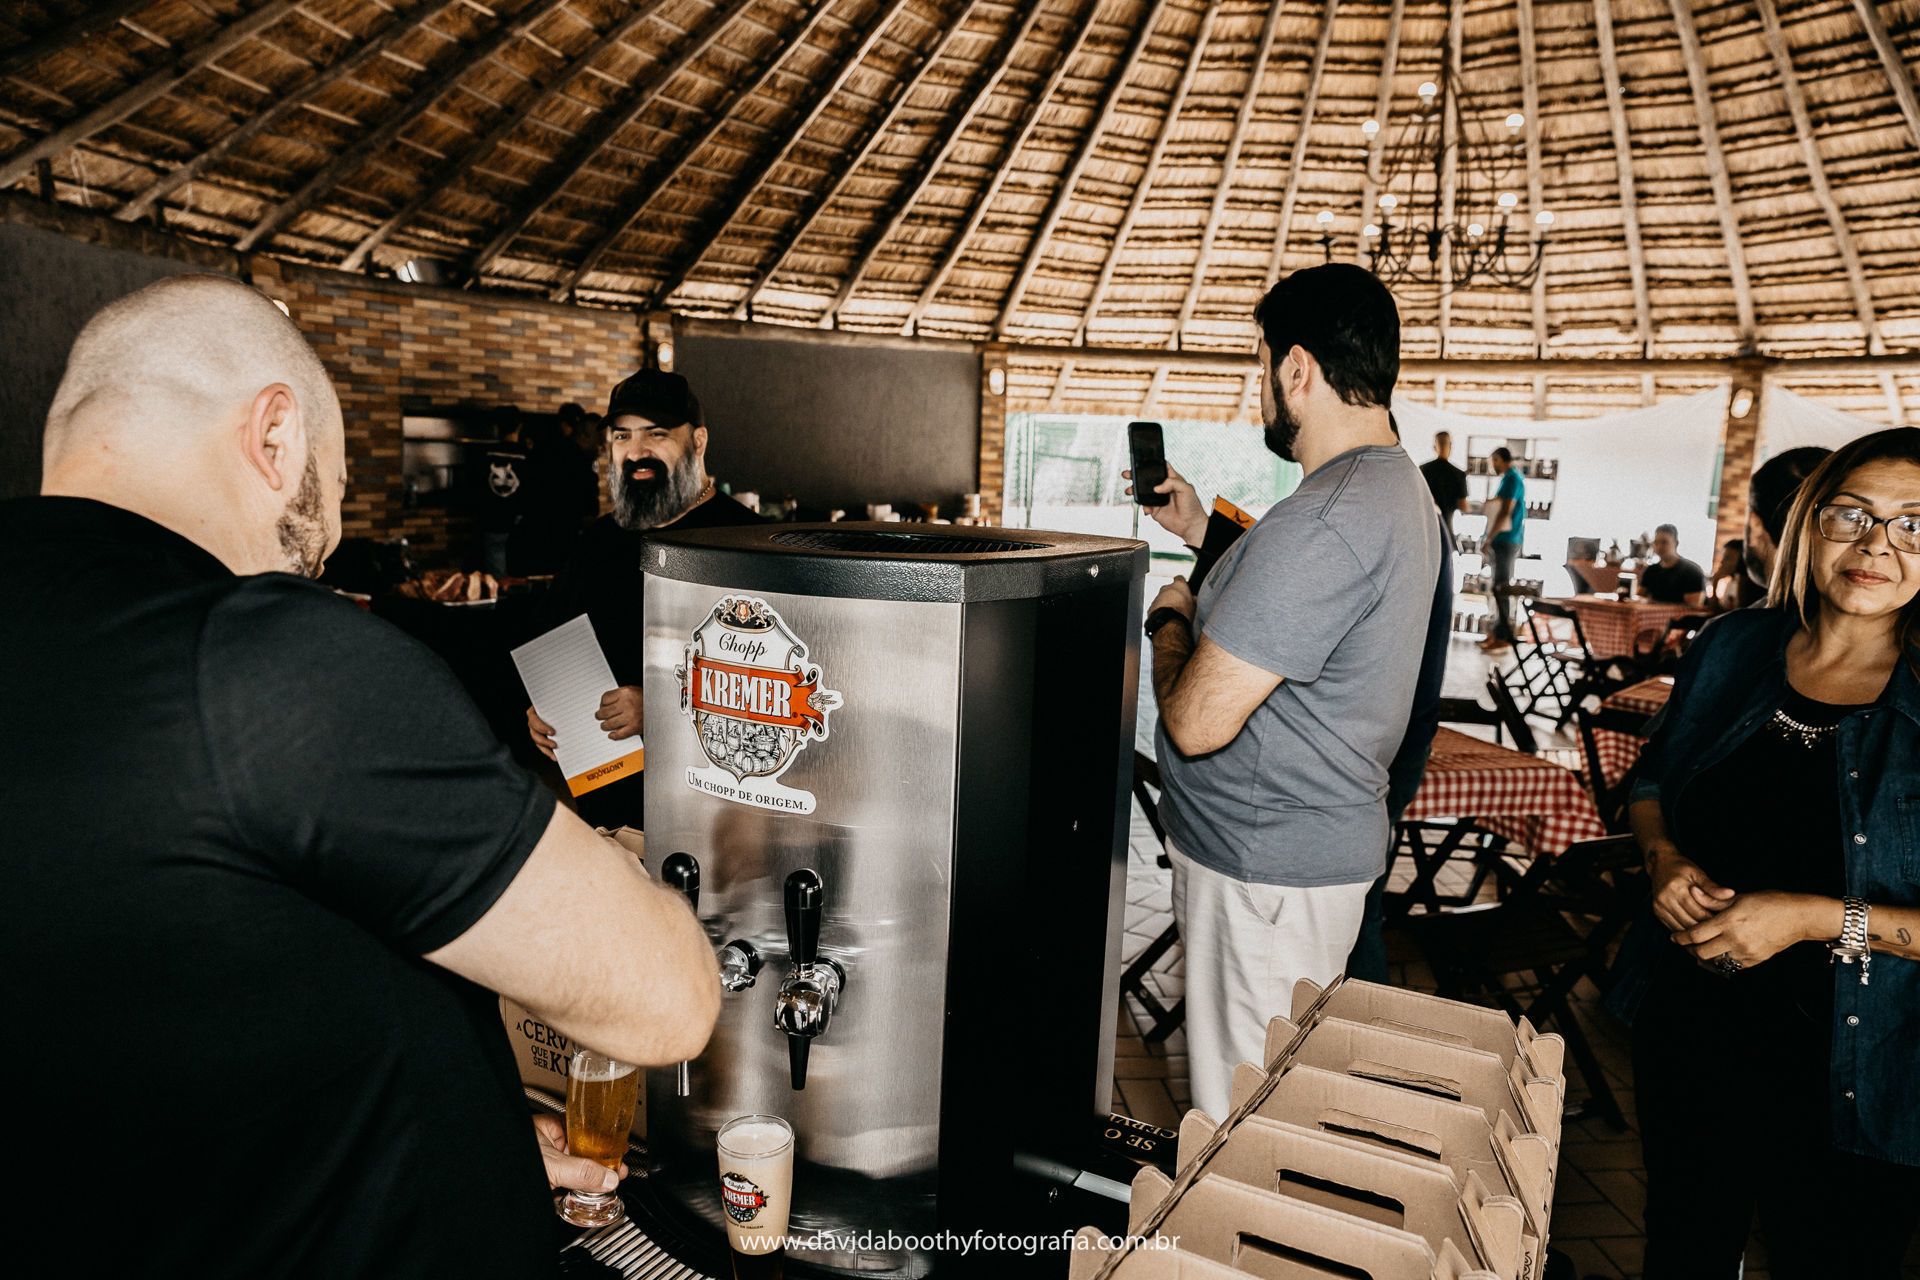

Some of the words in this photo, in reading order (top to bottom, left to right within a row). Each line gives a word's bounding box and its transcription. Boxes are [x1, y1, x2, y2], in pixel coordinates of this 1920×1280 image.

[719, 633, 768, 662] Chopp
[700, 667, 791, 718] KREMER
[704, 782, 736, 797] CHOPP
[738, 790, 753, 801] DE
[755, 793, 808, 811] ORIGEM.
[531, 1045, 548, 1059] QUE
[533, 1056, 548, 1069] SER
[1104, 1128, 1122, 1139] O
[1126, 1134, 1157, 1151] SE
